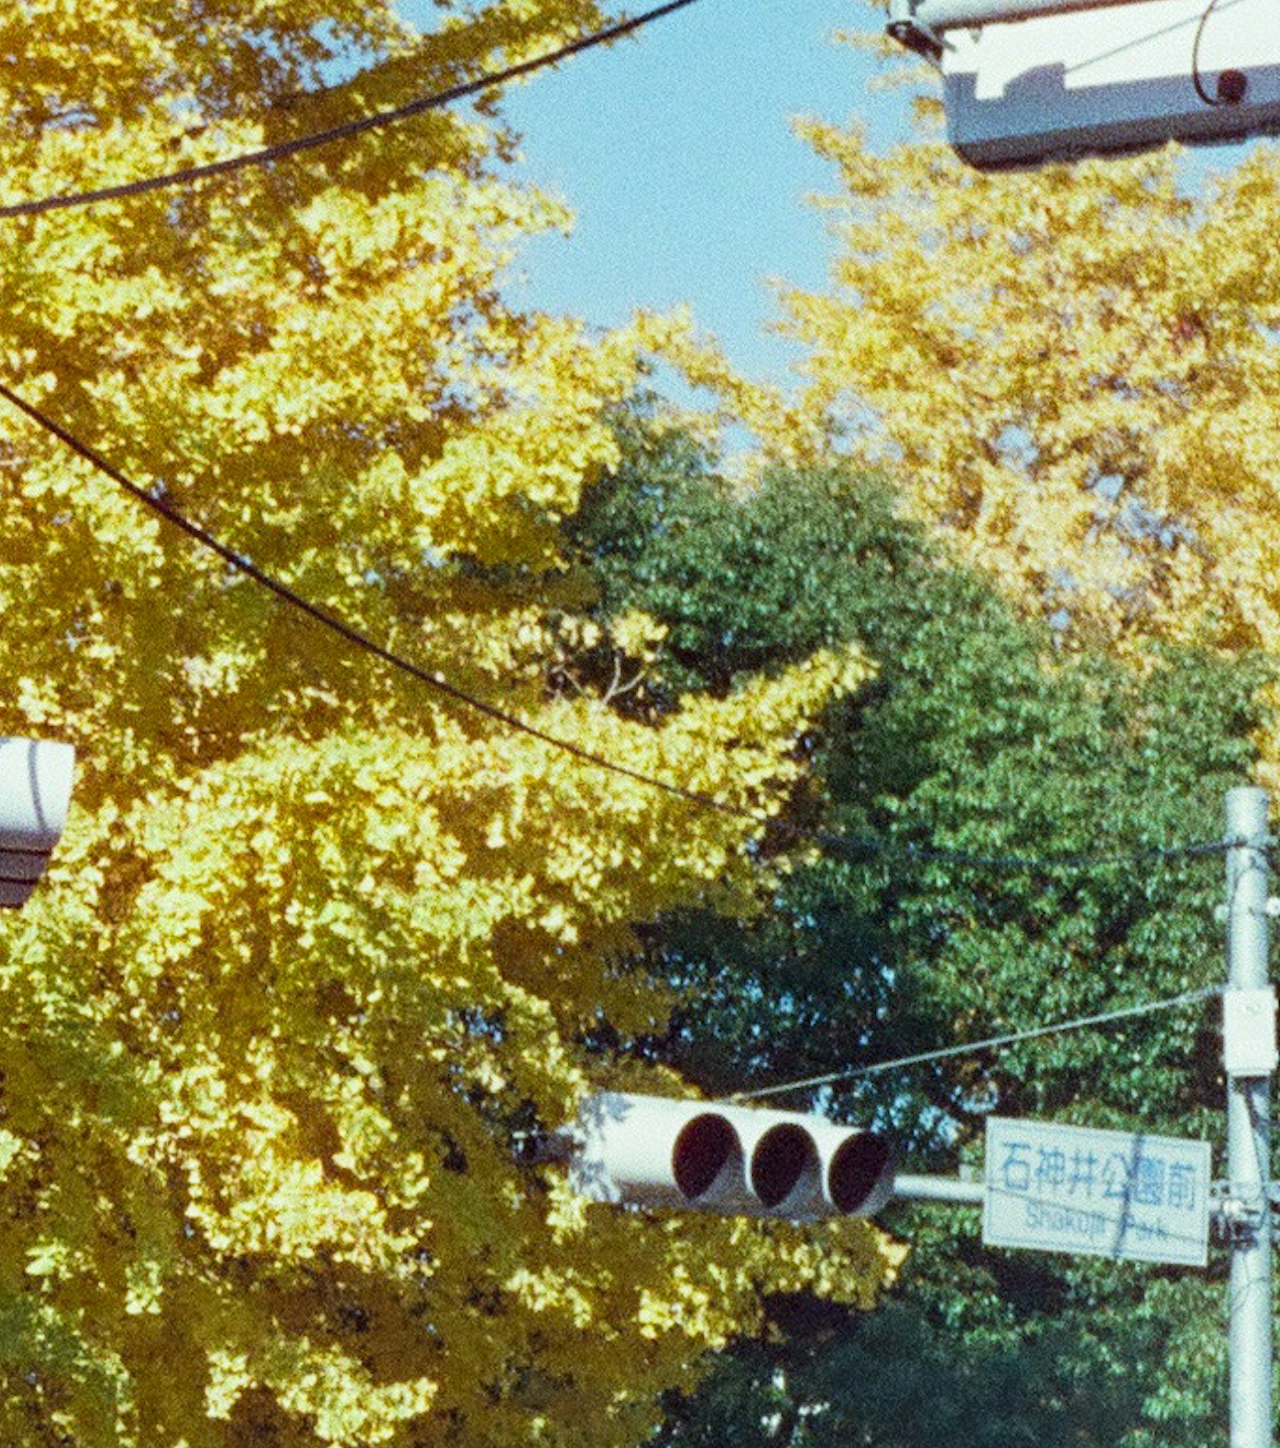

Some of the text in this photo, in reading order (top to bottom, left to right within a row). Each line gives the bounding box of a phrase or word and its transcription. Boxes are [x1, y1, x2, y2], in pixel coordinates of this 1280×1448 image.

[1001, 1140, 1196, 1211] 石神井公園前
